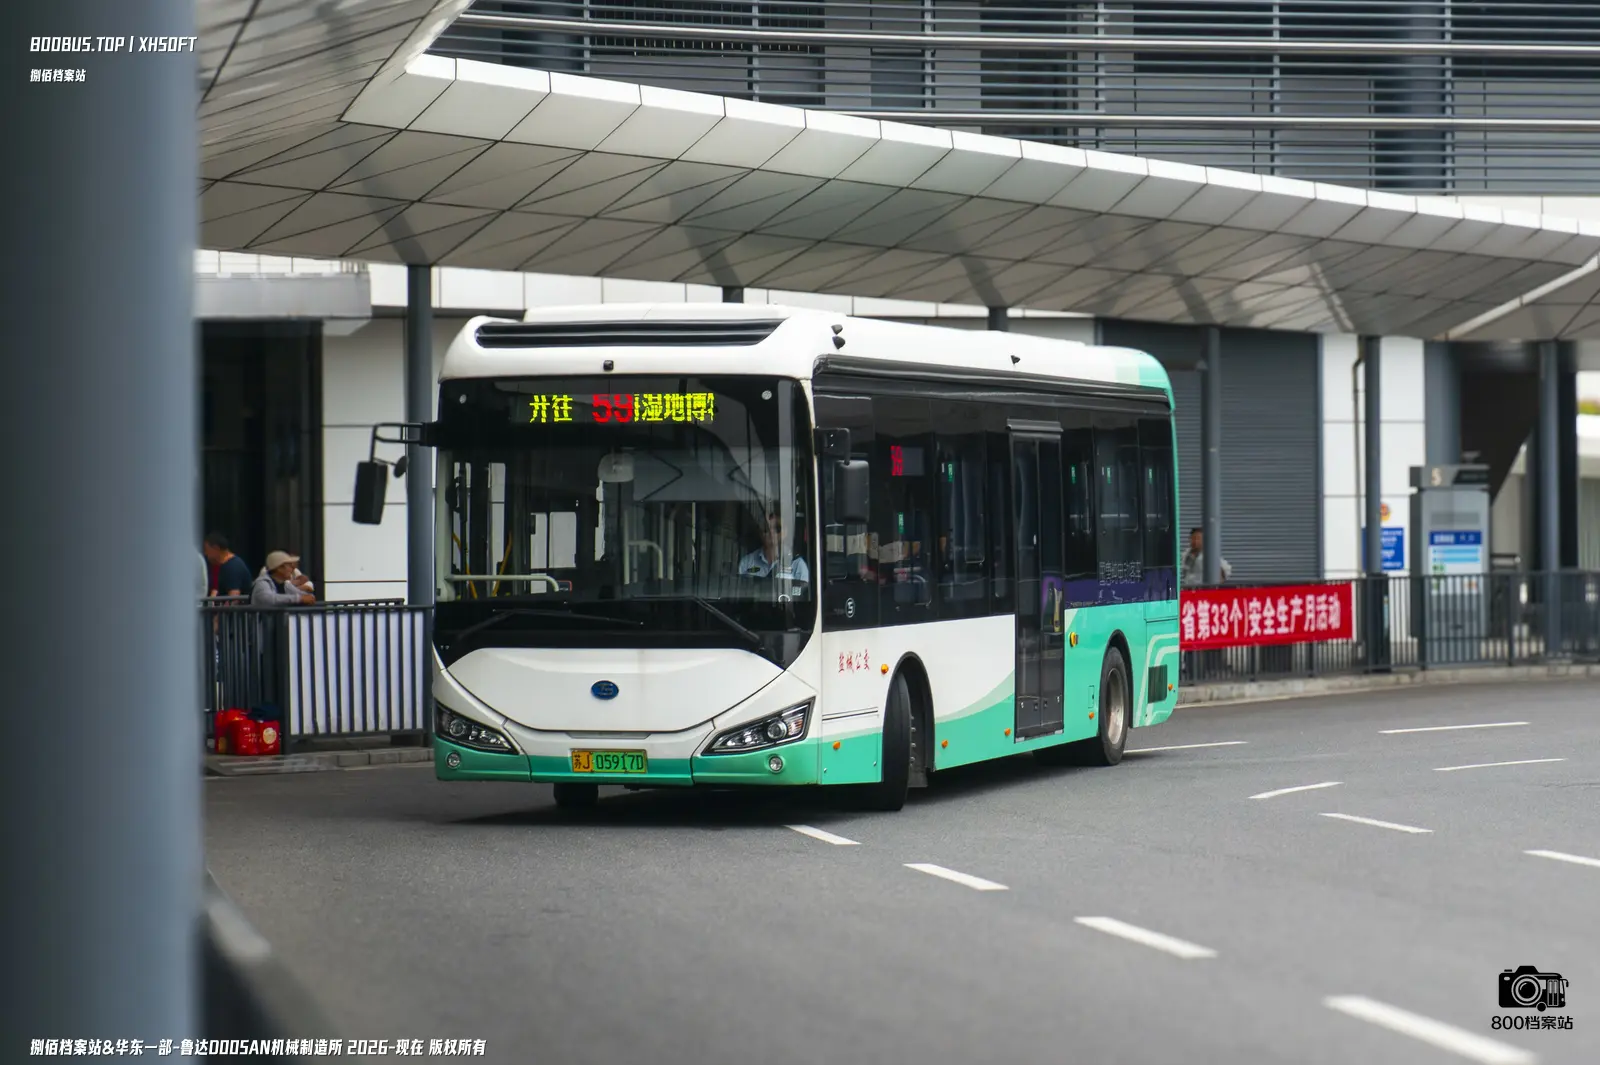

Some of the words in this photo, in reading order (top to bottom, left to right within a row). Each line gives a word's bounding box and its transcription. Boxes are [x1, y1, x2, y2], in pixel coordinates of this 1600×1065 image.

[592, 393, 634, 423] 59
[634, 392, 715, 422] 湿地博
[595, 754, 644, 770] 05917D
